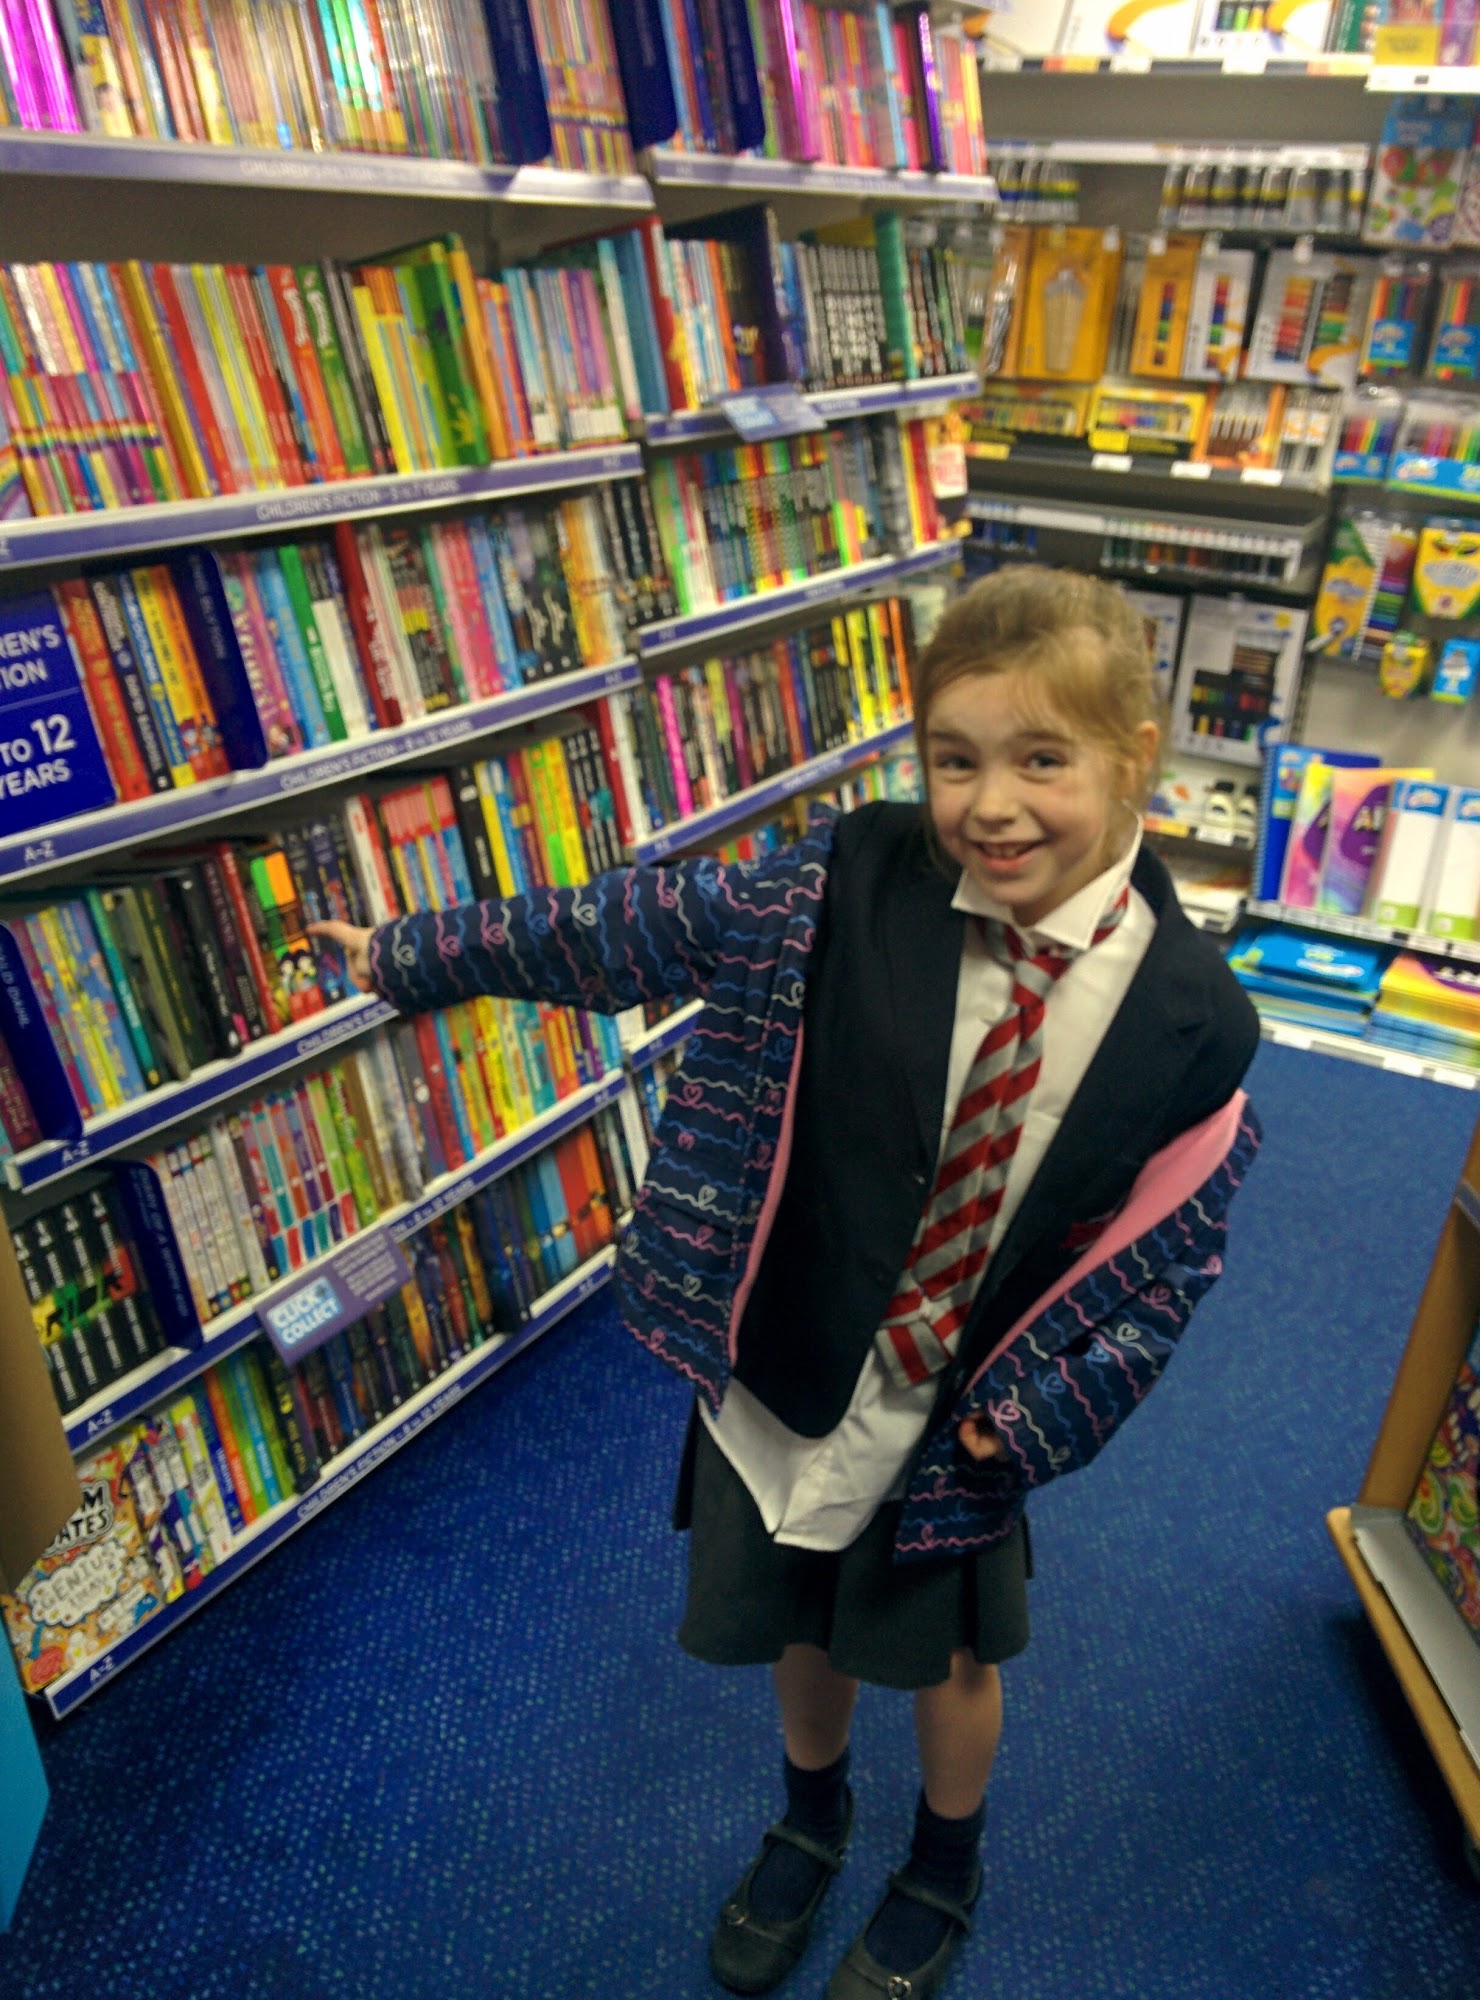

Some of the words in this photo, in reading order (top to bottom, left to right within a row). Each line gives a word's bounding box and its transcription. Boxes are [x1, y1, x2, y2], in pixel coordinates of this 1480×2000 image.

[0, 624, 60, 659] EN'S
[0, 658, 48, 690] ION
[30, 713, 77, 756] 12
[24, 840, 55, 865] A-Z
[62, 1140, 90, 1163] A-Z
[271, 1287, 320, 1329] CLICK
[281, 1298, 340, 1345] COLLECT
[87, 1409, 114, 1435] A-Z
[55, 1508, 107, 1545] ATES
[90, 1655, 115, 1683] A-Z
